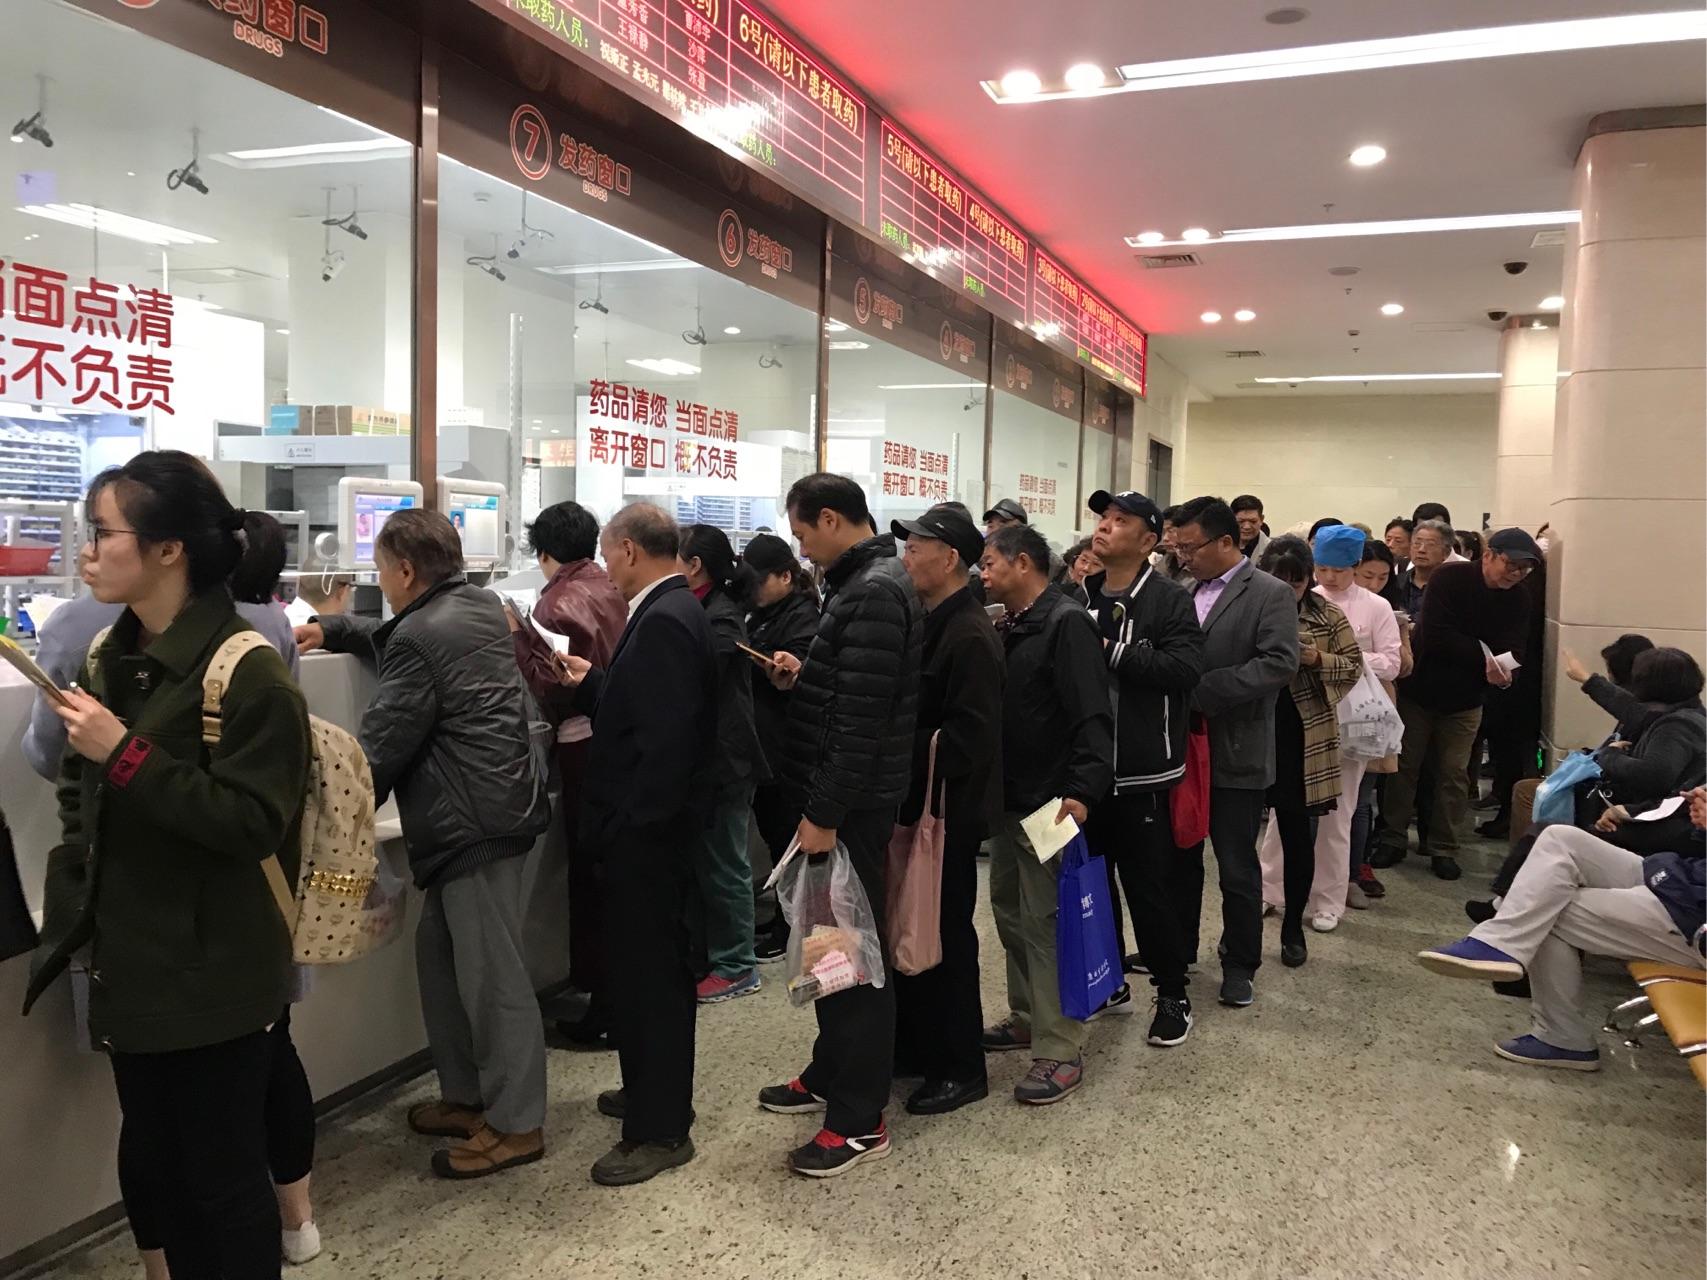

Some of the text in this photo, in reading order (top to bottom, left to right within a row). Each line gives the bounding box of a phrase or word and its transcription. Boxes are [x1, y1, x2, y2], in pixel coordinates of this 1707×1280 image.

[233, 20, 284, 58] DRUGS
[740, 13, 858, 134] 6号(请以下患者取药)
[558, 132, 632, 197] 发药窗口
[582, 178, 608, 203] DRUGS
[887, 133, 962, 214] 5号(请以下患者取药)
[746, 227, 793, 273] 发药窗口
[0, 257, 175, 349] 面点清
[0, 333, 175, 415] 不负责
[589, 378, 739, 443] 药品请您 当面点清
[589, 426, 666, 469] 离开窗口
[674, 438, 738, 481] 概不负责
[883, 471, 916, 497] 离开窗口
